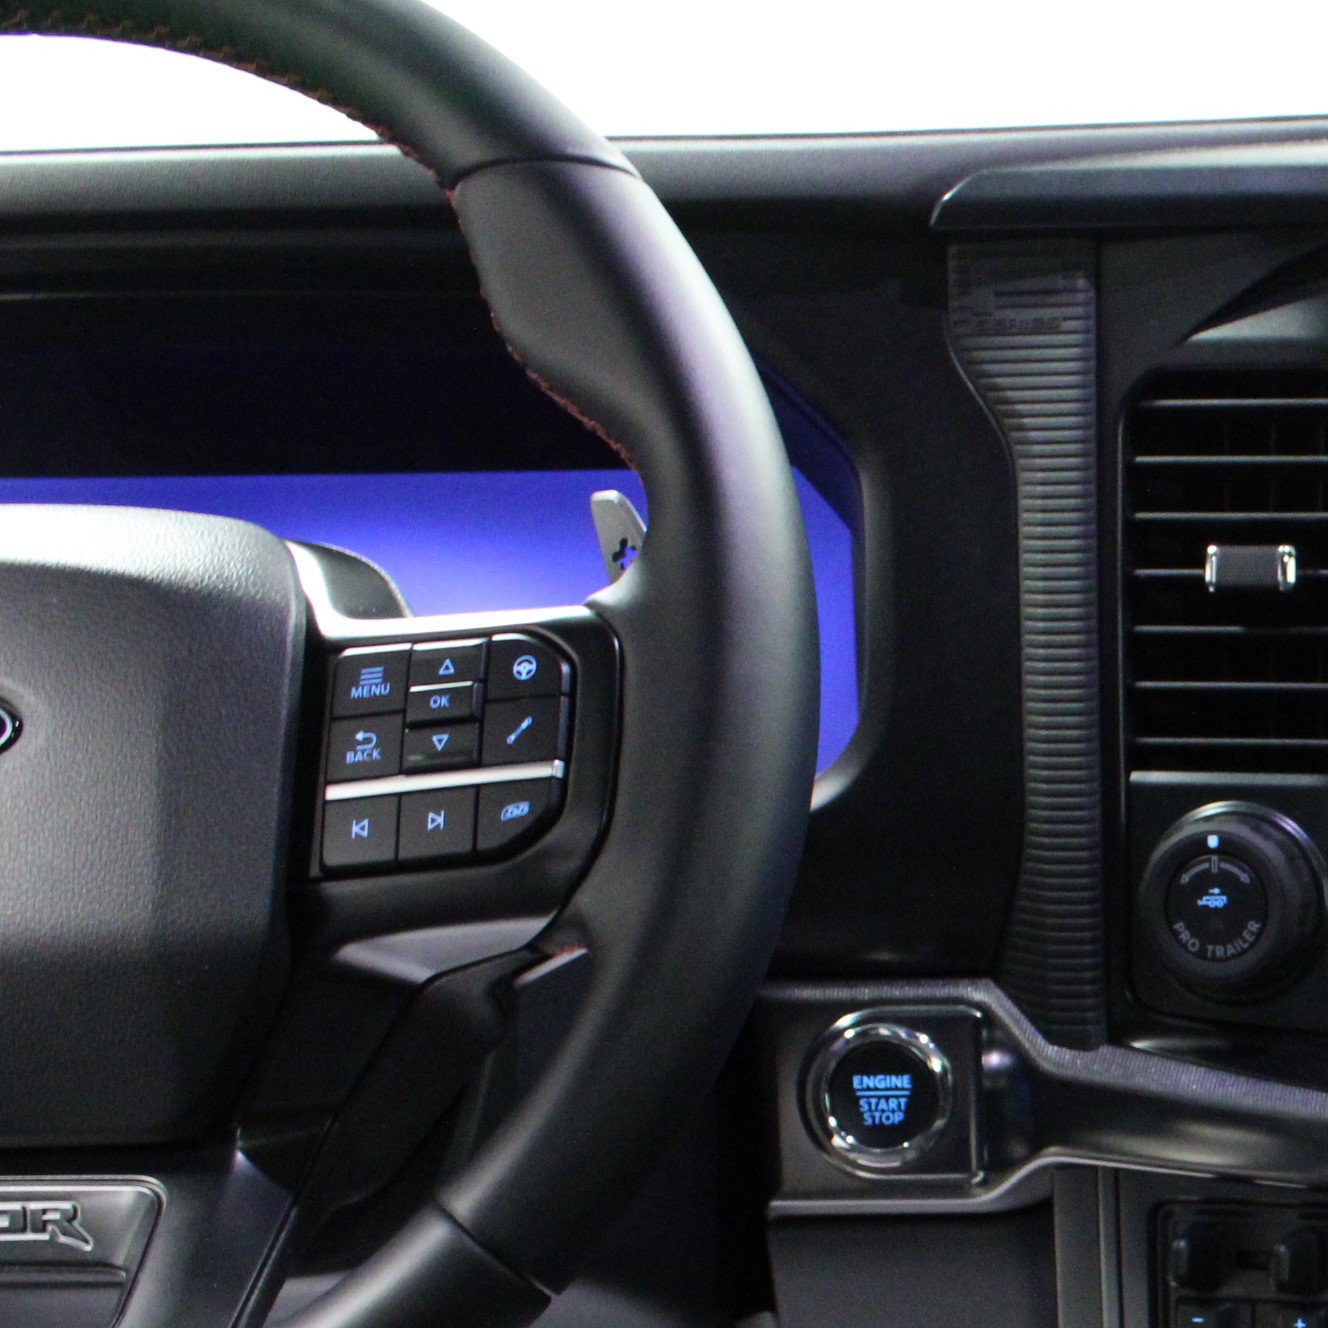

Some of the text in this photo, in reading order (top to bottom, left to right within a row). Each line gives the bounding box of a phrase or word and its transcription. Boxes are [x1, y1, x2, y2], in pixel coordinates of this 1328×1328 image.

[350, 683, 390, 699] MENU
[429, 694, 450, 709] OK
[346, 748, 381, 764] BACK
[1172, 919, 1262, 959] PRO TRAILER
[853, 1074, 913, 1090] ENGINE
[858, 1097, 908, 1113] START
[863, 1111, 905, 1126] STOP
